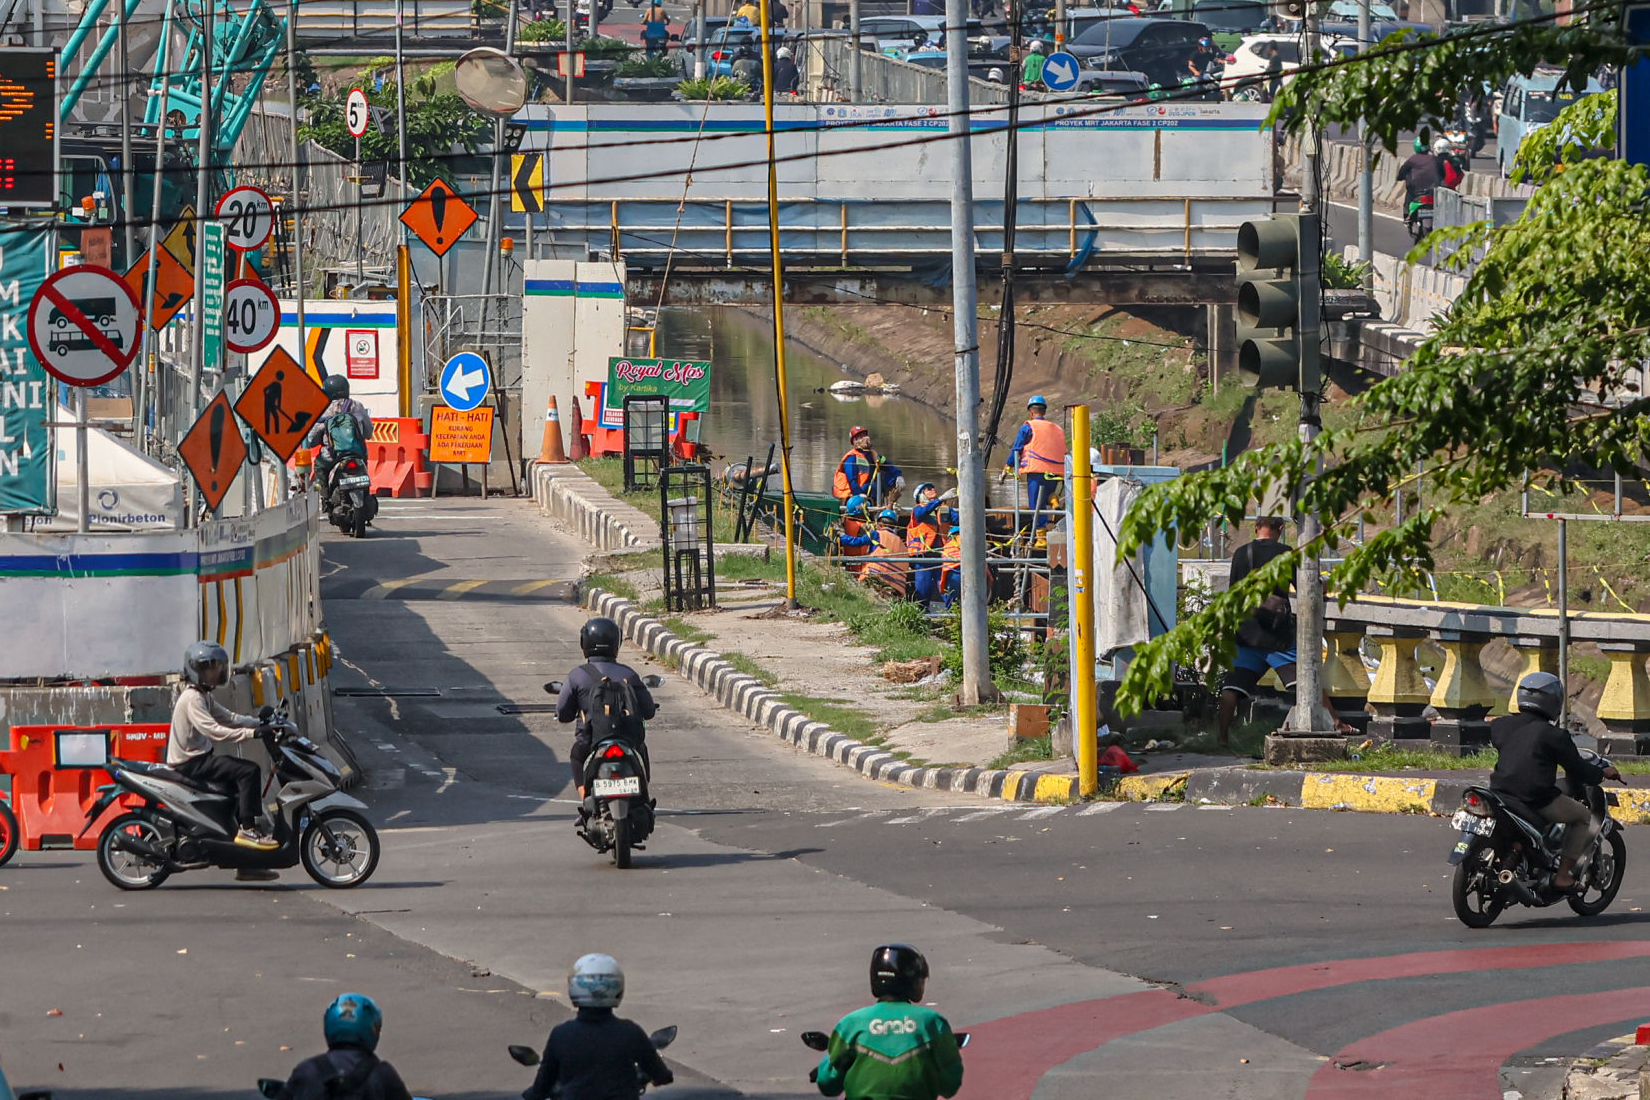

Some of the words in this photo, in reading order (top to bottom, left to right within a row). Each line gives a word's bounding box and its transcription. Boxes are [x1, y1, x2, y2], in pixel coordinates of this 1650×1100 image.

[349, 102, 358, 128] 5
[228, 200, 256, 239] 20
[227, 298, 256, 335] 40
[258, 298, 268, 310] km
[615, 360, 663, 383] Royal
[663, 362, 705, 386] Mas
[618, 384, 628, 392] by
[630, 384, 658, 392] Kartika
[436, 412, 459, 421] HATI
[467, 412, 489, 421] HATI
[869, 1015, 917, 1035] Grab
